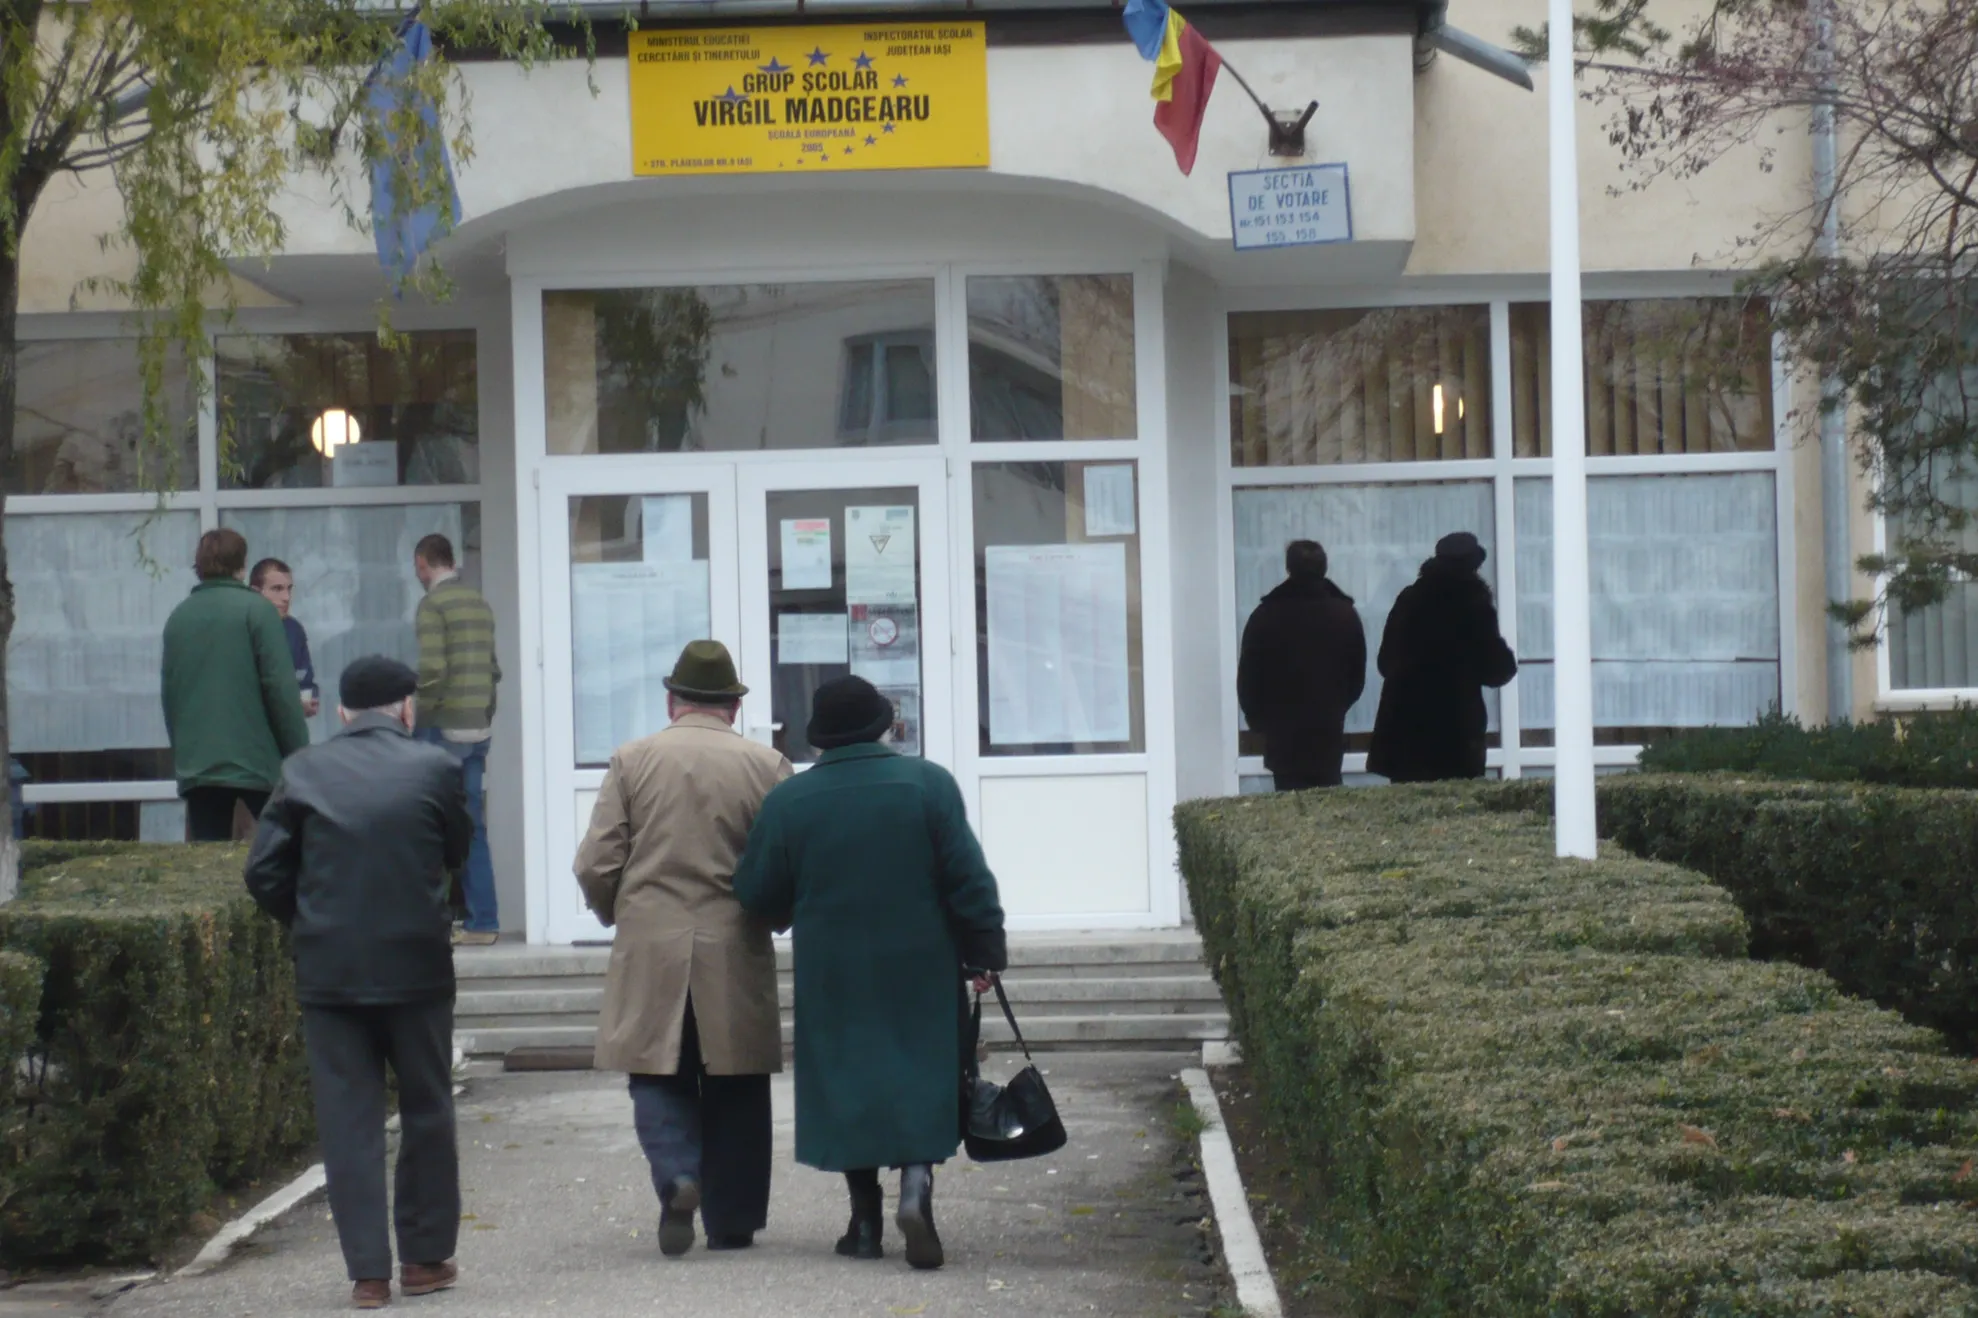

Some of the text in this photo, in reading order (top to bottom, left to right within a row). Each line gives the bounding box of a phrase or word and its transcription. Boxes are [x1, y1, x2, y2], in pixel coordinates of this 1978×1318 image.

[647, 35, 700, 47] MINISTERUL
[864, 29, 936, 42] INSPECTORATUL
[703, 48, 761, 61] TINERETULUI
[743, 72, 795, 93] GRUP
[693, 94, 930, 127] VIRGIL MADGEARU
[801, 142, 824, 154] 2005
[1248, 188, 1330, 211] DE VOTARE
